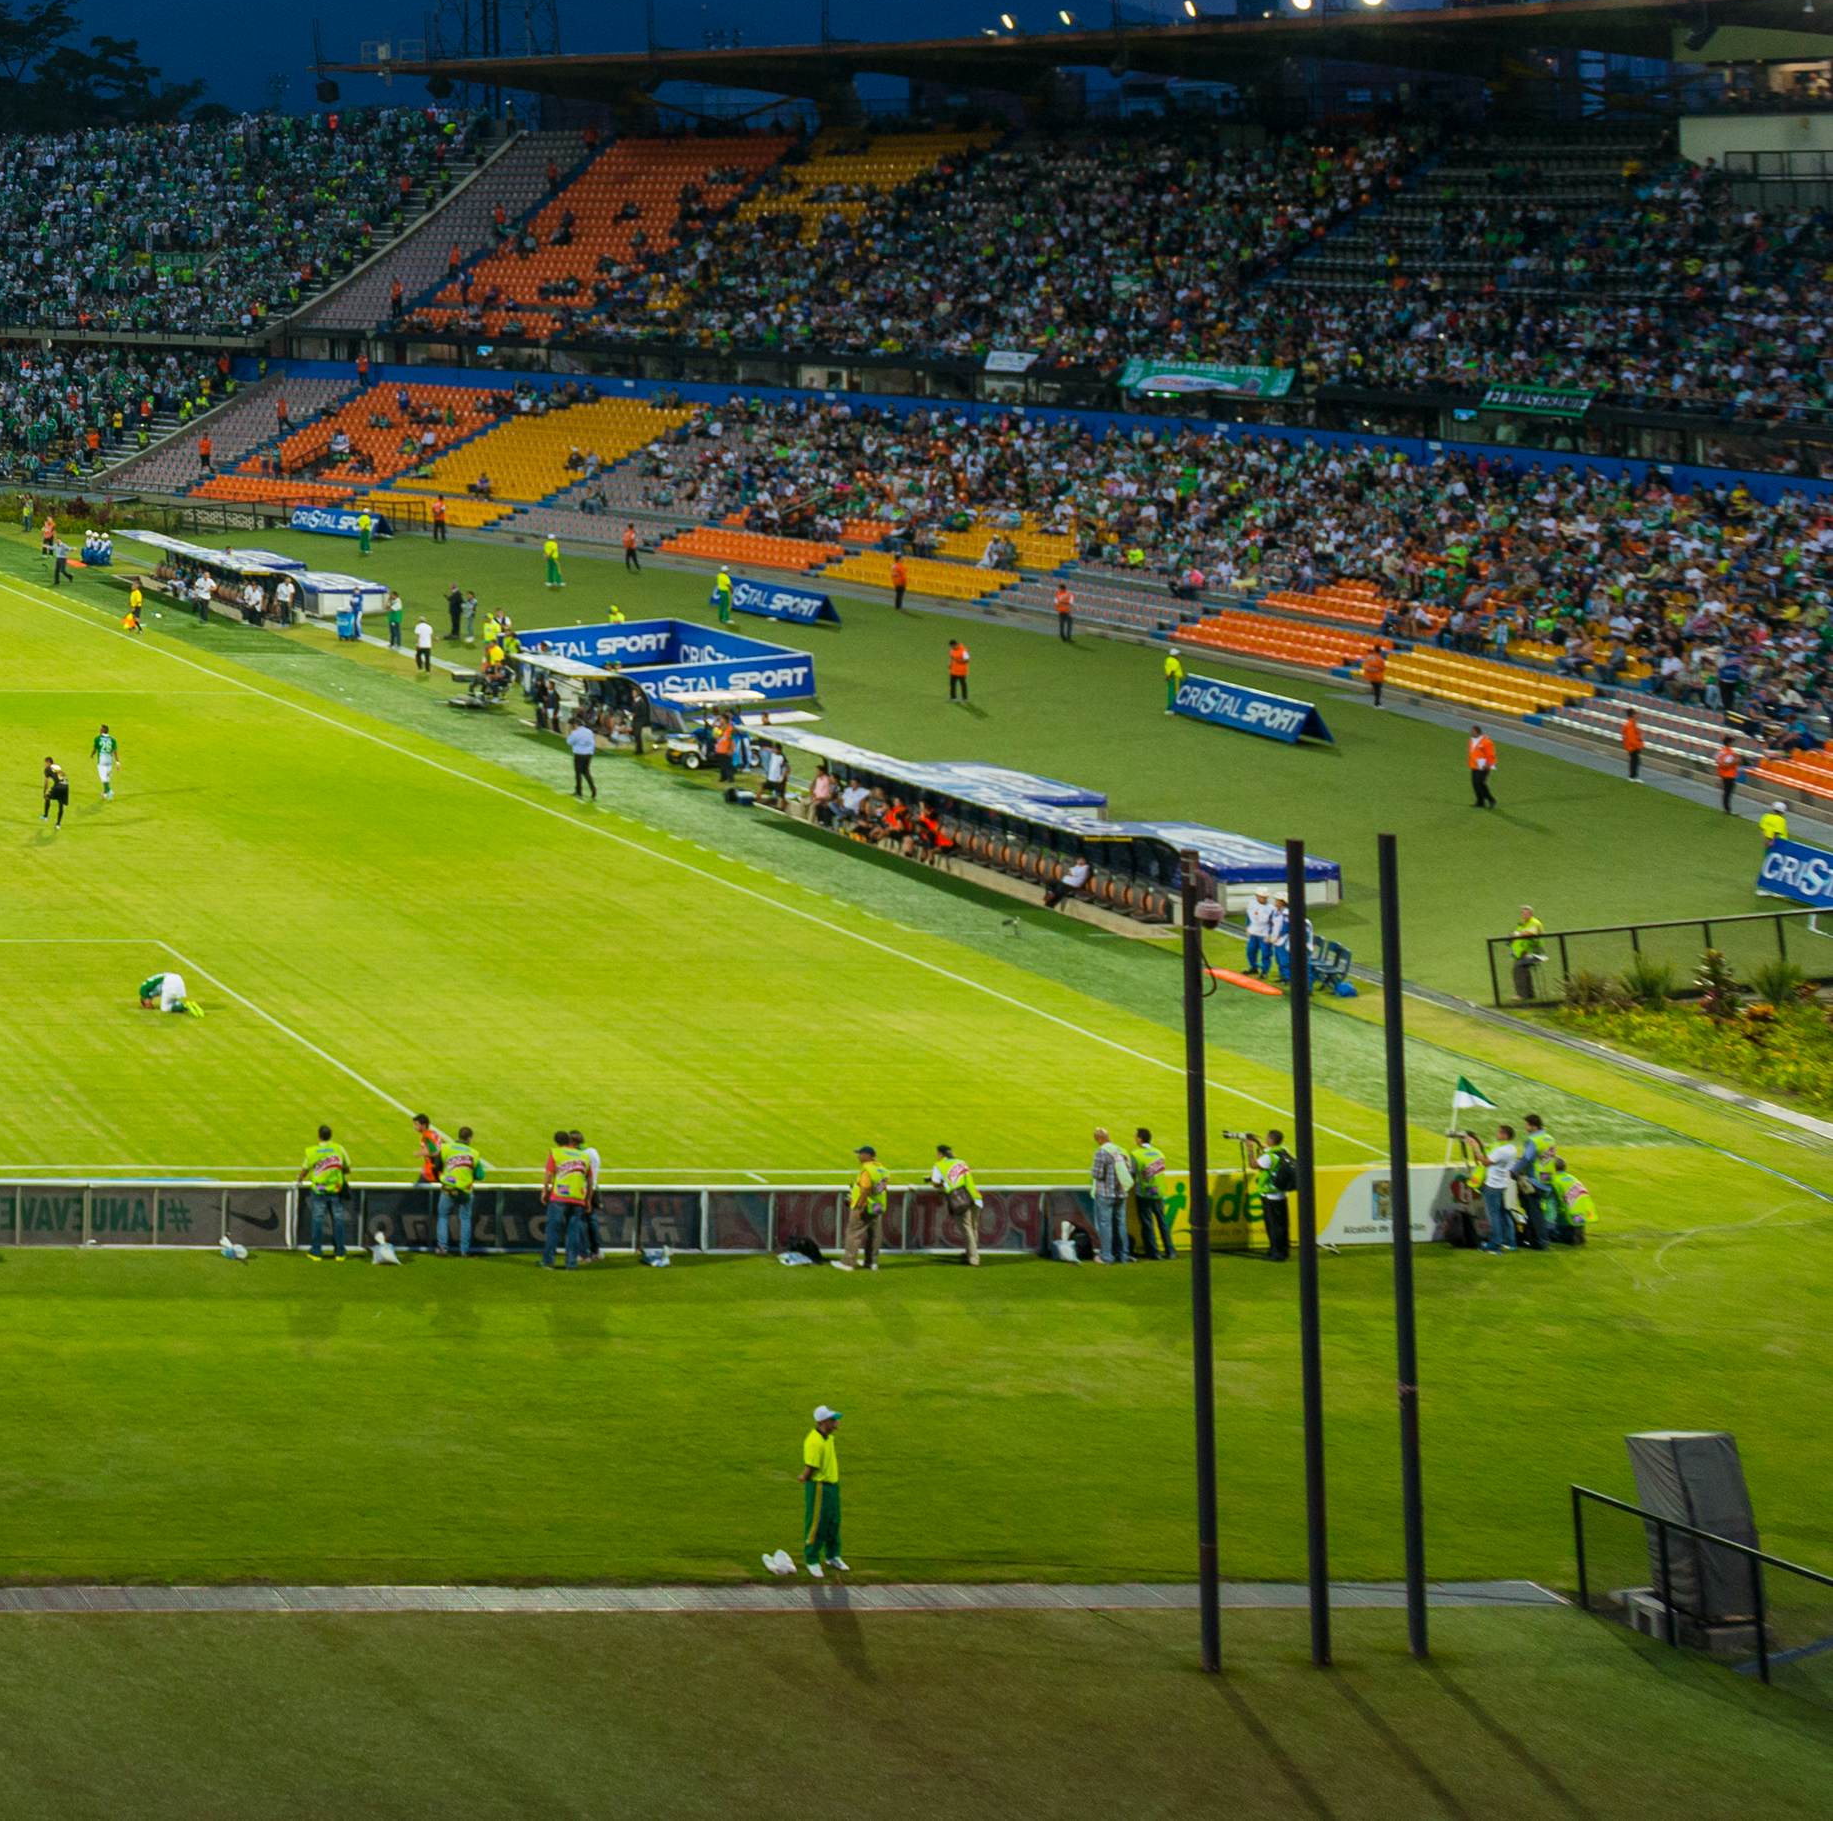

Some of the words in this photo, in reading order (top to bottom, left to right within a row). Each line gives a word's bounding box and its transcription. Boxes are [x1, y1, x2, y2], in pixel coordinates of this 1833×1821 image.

[291, 510, 336, 528] CRISTAL
[337, 516, 380, 535] SPOT
[769, 596, 822, 617] SPORT
[596, 632, 671, 656] SPORT
[728, 667, 808, 692] SPORT
[1175, 685, 1242, 718] CRISTAL
[1242, 701, 1306, 733] SPORT
